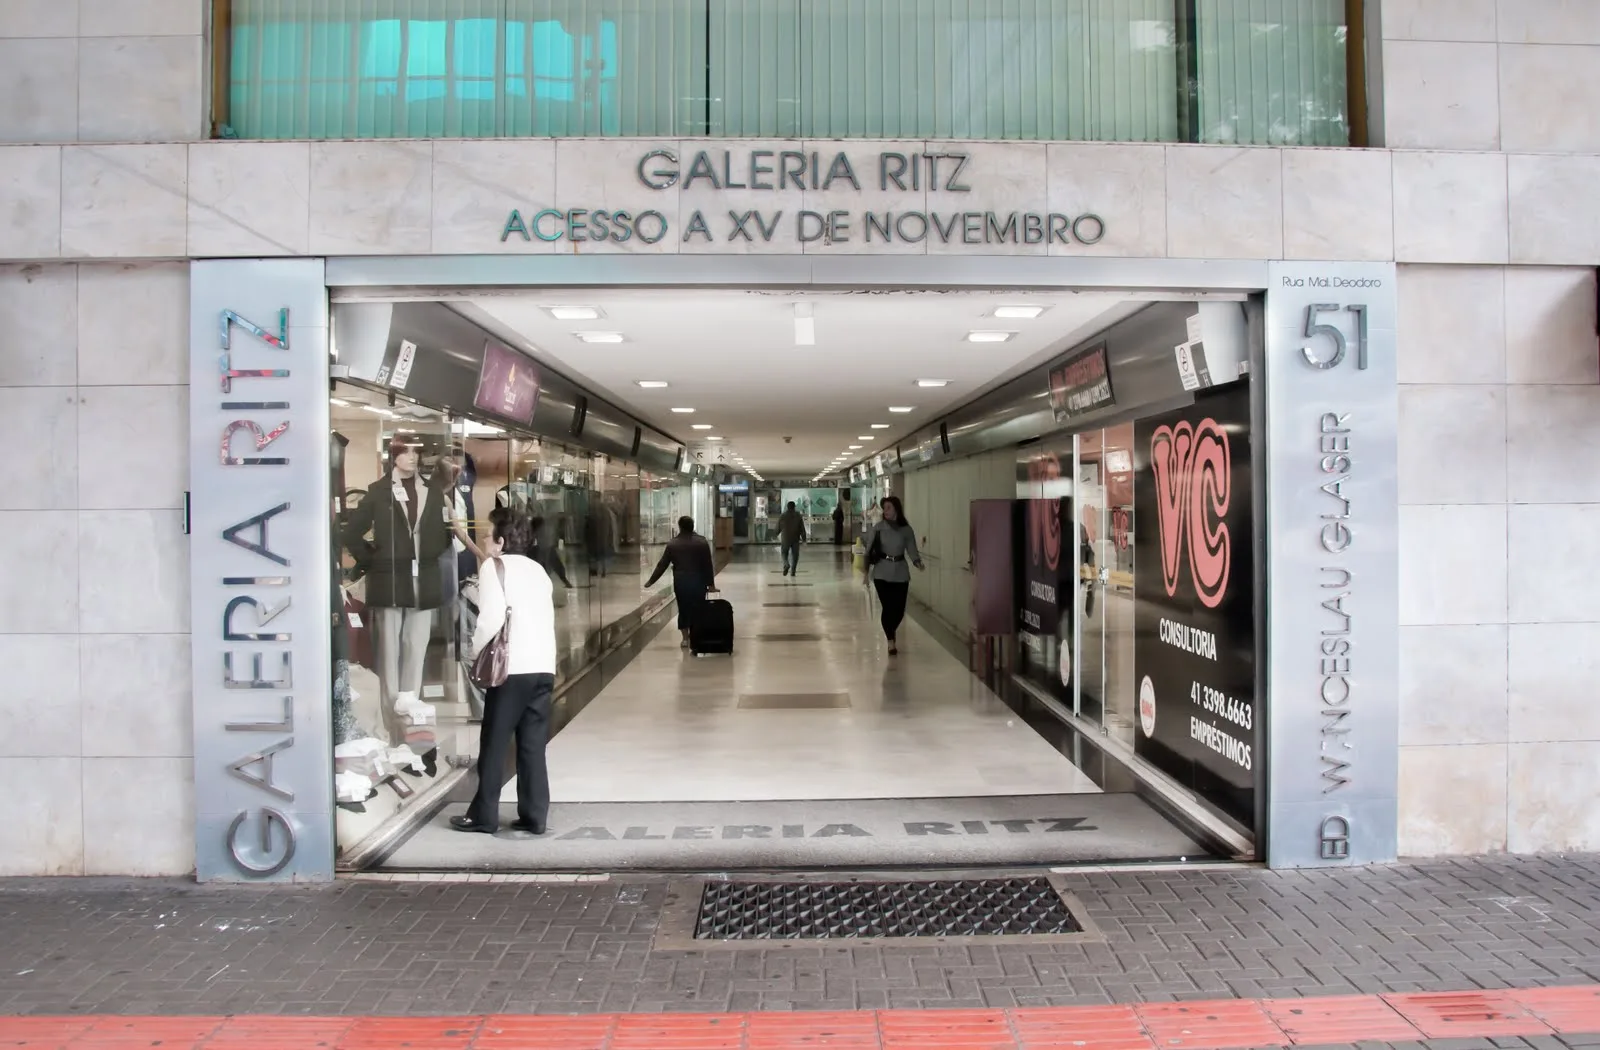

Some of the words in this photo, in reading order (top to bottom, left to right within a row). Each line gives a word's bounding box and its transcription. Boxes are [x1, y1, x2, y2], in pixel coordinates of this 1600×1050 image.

[637, 149, 860, 190] GALERIA
[879, 152, 972, 193] RITZ
[499, 208, 668, 244] ACESSO
[682, 210, 714, 243] A
[727, 210, 783, 242] XV
[797, 210, 850, 242] DE
[865, 210, 1106, 245] NOVEMBRO
[1282, 275, 1304, 288] Rua
[1308, 276, 1332, 289] Mal.
[1333, 276, 1382, 288] Deodoro
[1301, 302, 1369, 371] 51
[219, 306, 291, 466] RITZ
[1319, 411, 1353, 554] GLASER
[1151, 417, 1231, 609] VC
[1159, 617, 1217, 661] CONSULTORIA
[222, 500, 297, 878] GALERIA
[1190, 680, 1201, 705] 41
[1202, 685, 1252, 730] 3398.6663
[1320, 566, 1352, 795] WNCESLAU
[1190, 715, 1252, 770] EMPRÉSTIMOS
[903, 817, 1098, 835] RITZ
[1319, 814, 1351, 861] ED
